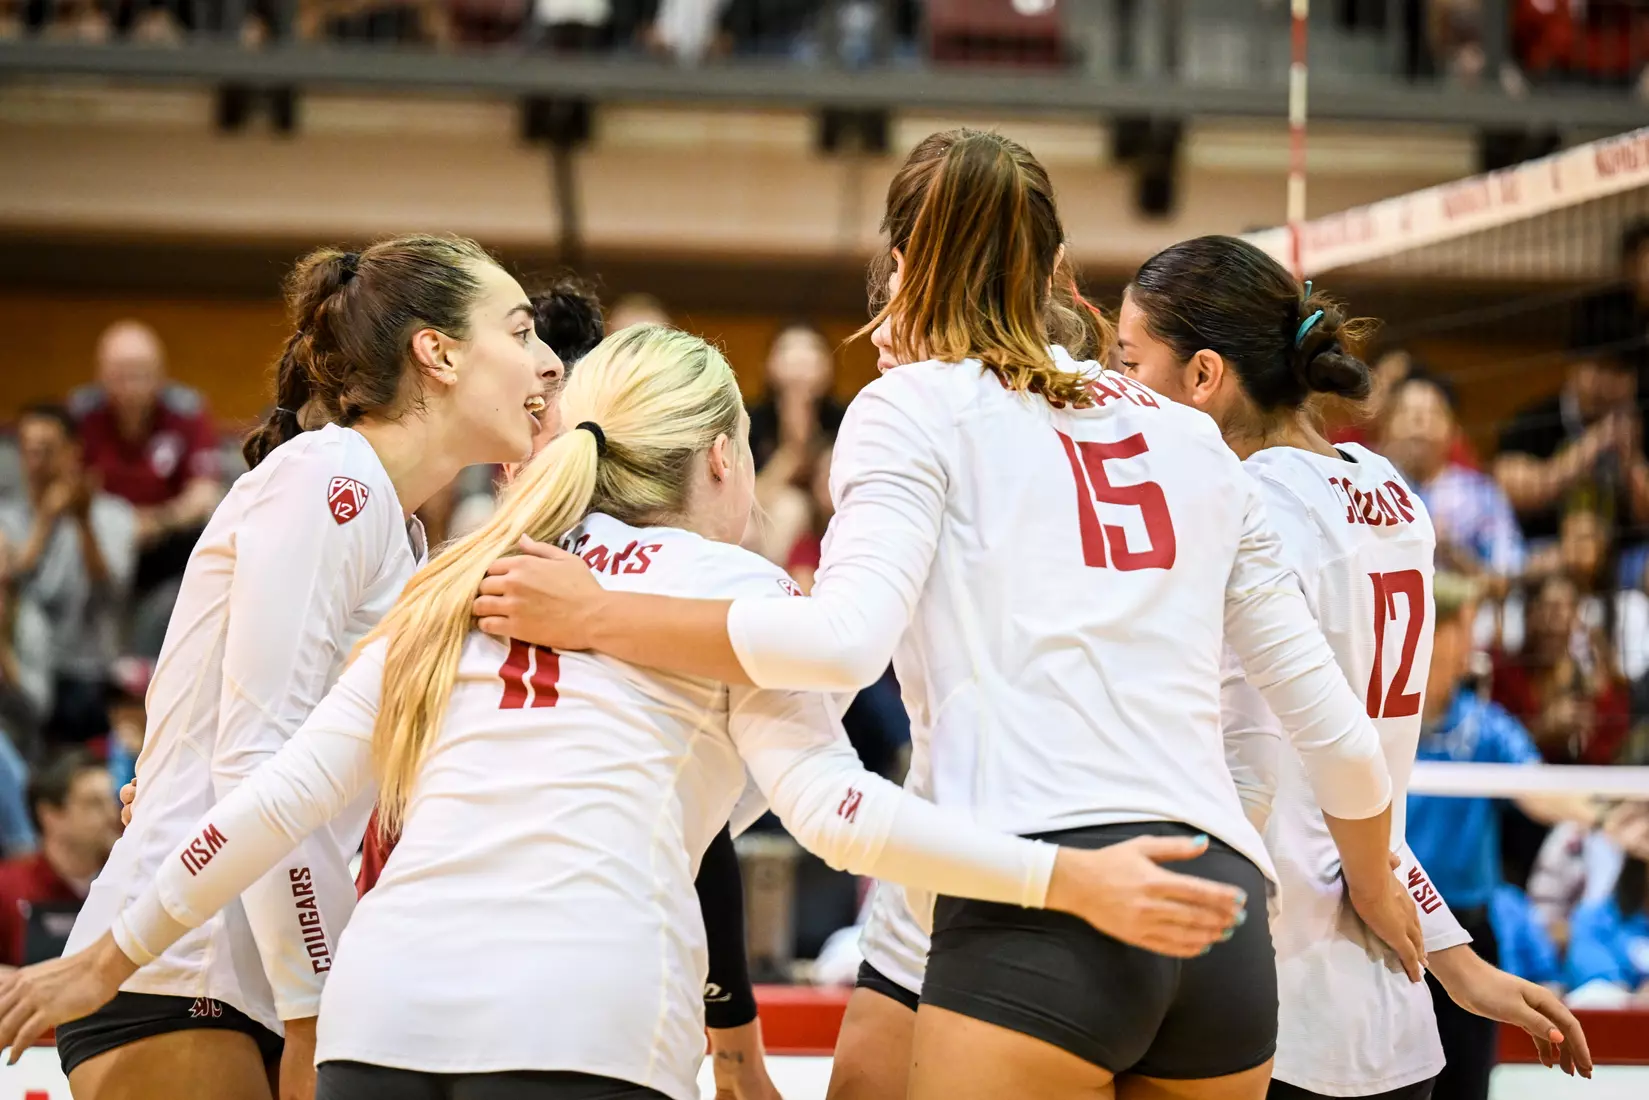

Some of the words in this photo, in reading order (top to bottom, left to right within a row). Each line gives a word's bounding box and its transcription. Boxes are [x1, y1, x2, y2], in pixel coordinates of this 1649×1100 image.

[329, 478, 369, 512] PAC
[334, 501, 354, 519] 12
[1053, 432, 1176, 571] 15
[498, 637, 560, 710] 11
[1366, 569, 1425, 719] 12
[180, 823, 229, 876] WSU
[289, 867, 332, 975] COUGARS
[1408, 865, 1443, 915] WSU
